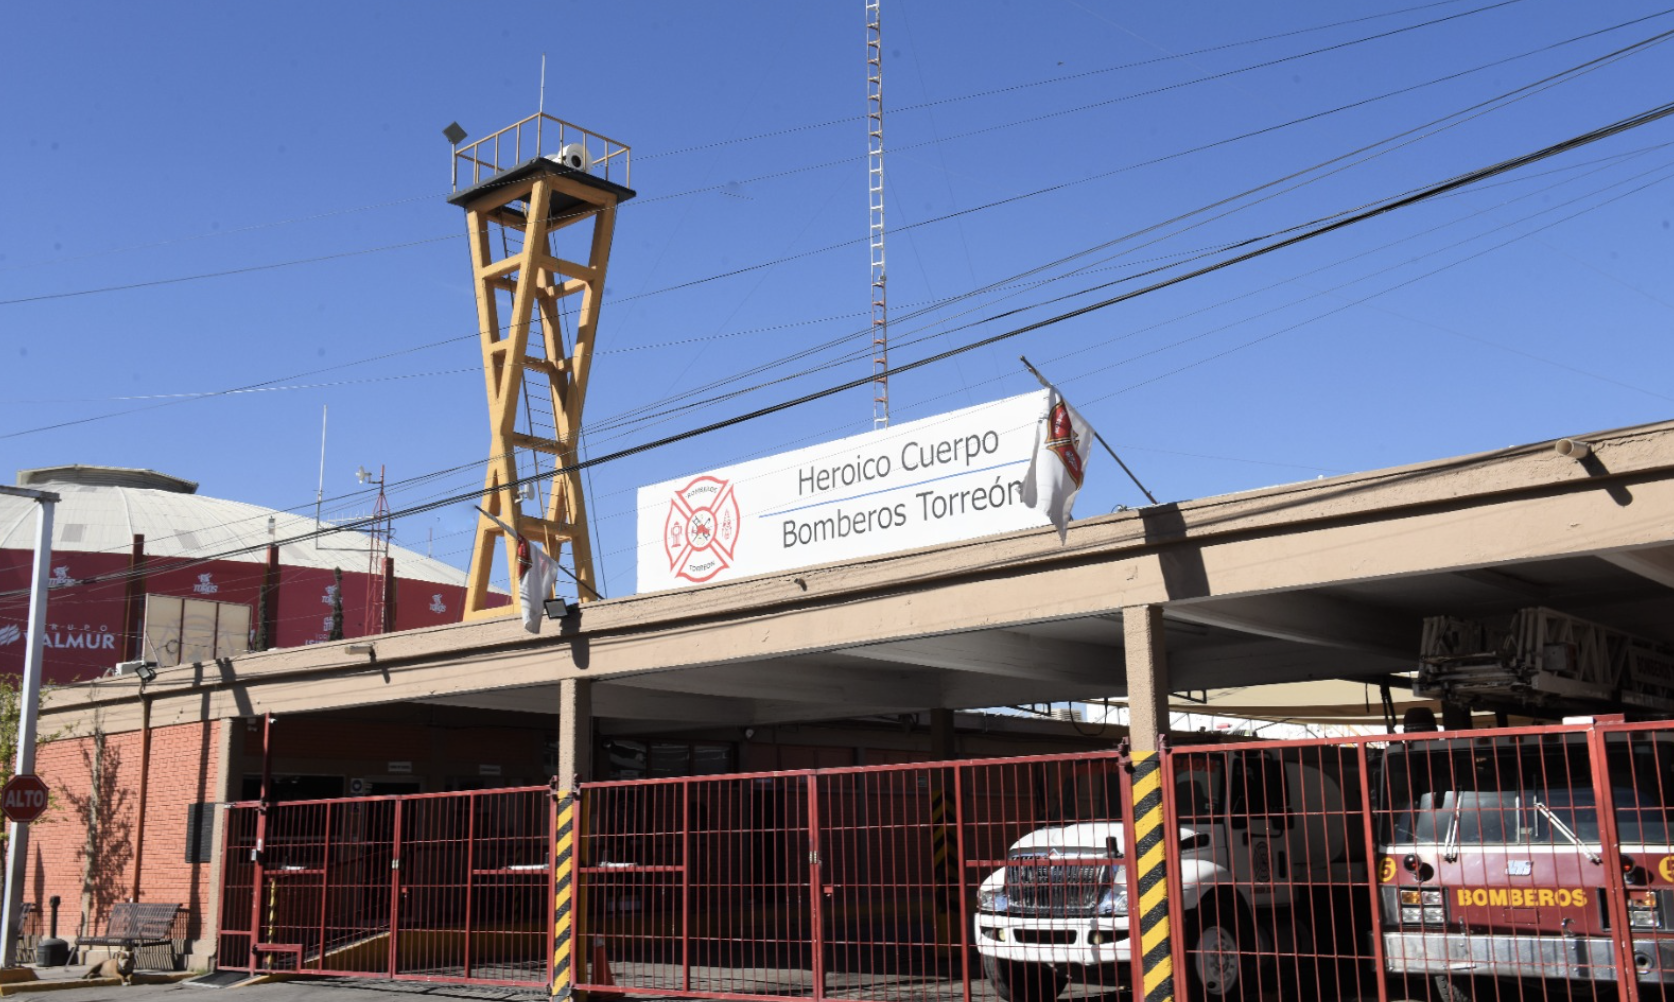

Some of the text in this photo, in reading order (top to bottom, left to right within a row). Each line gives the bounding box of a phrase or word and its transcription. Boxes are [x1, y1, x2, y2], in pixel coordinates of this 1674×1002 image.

[798, 430, 1000, 496] Heroico Cuerpo
[782, 475, 1023, 549] Bomberos Torreón
[51, 623, 108, 633] RUPO
[23, 631, 115, 650] ALMUR
[4, 789, 45, 808] ALTO
[1457, 888, 1588, 907] BOMBEROS
